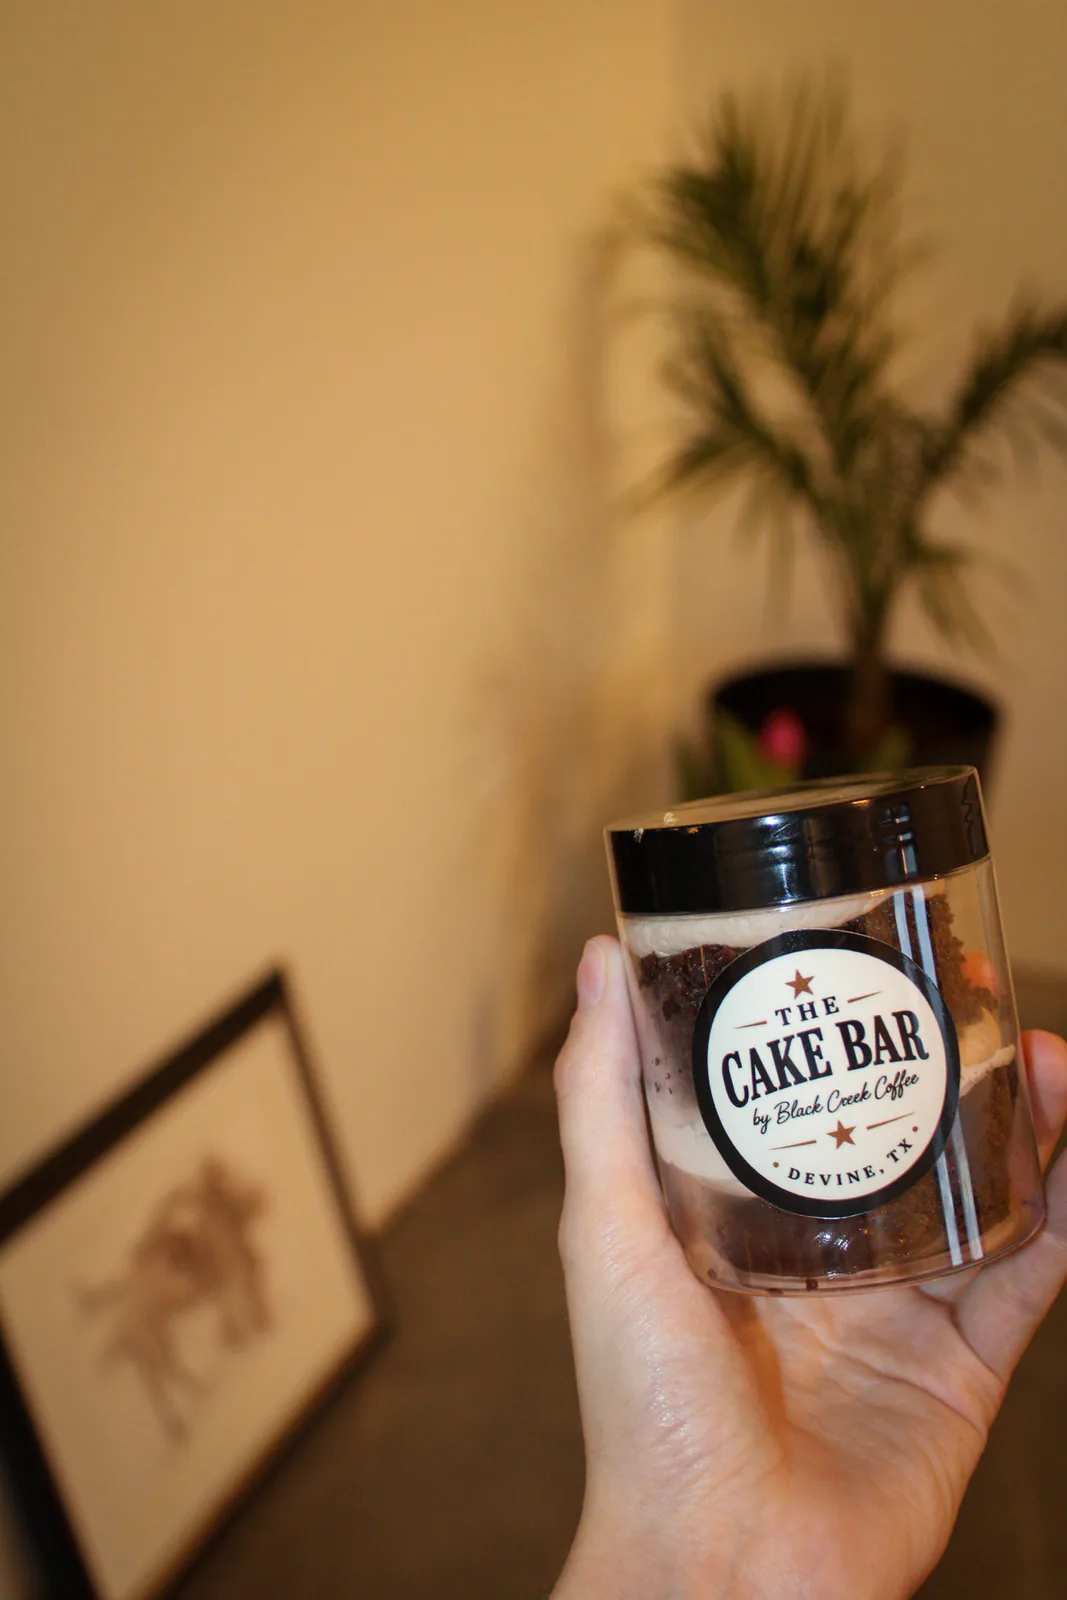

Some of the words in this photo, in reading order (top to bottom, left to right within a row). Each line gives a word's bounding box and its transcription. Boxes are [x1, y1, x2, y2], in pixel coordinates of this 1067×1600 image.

[775, 995, 840, 1026] THE
[721, 1027, 833, 1108] CAKE
[835, 1010, 930, 1072] BAR
[752, 1108, 772, 1134] by
[774, 1095, 823, 1125] Black
[827, 1082, 872, 1113] Creek
[874, 1069, 920, 1101] Coffee
[787, 1165, 885, 1186] DEVINE,
[886, 1139, 913, 1164] TX
